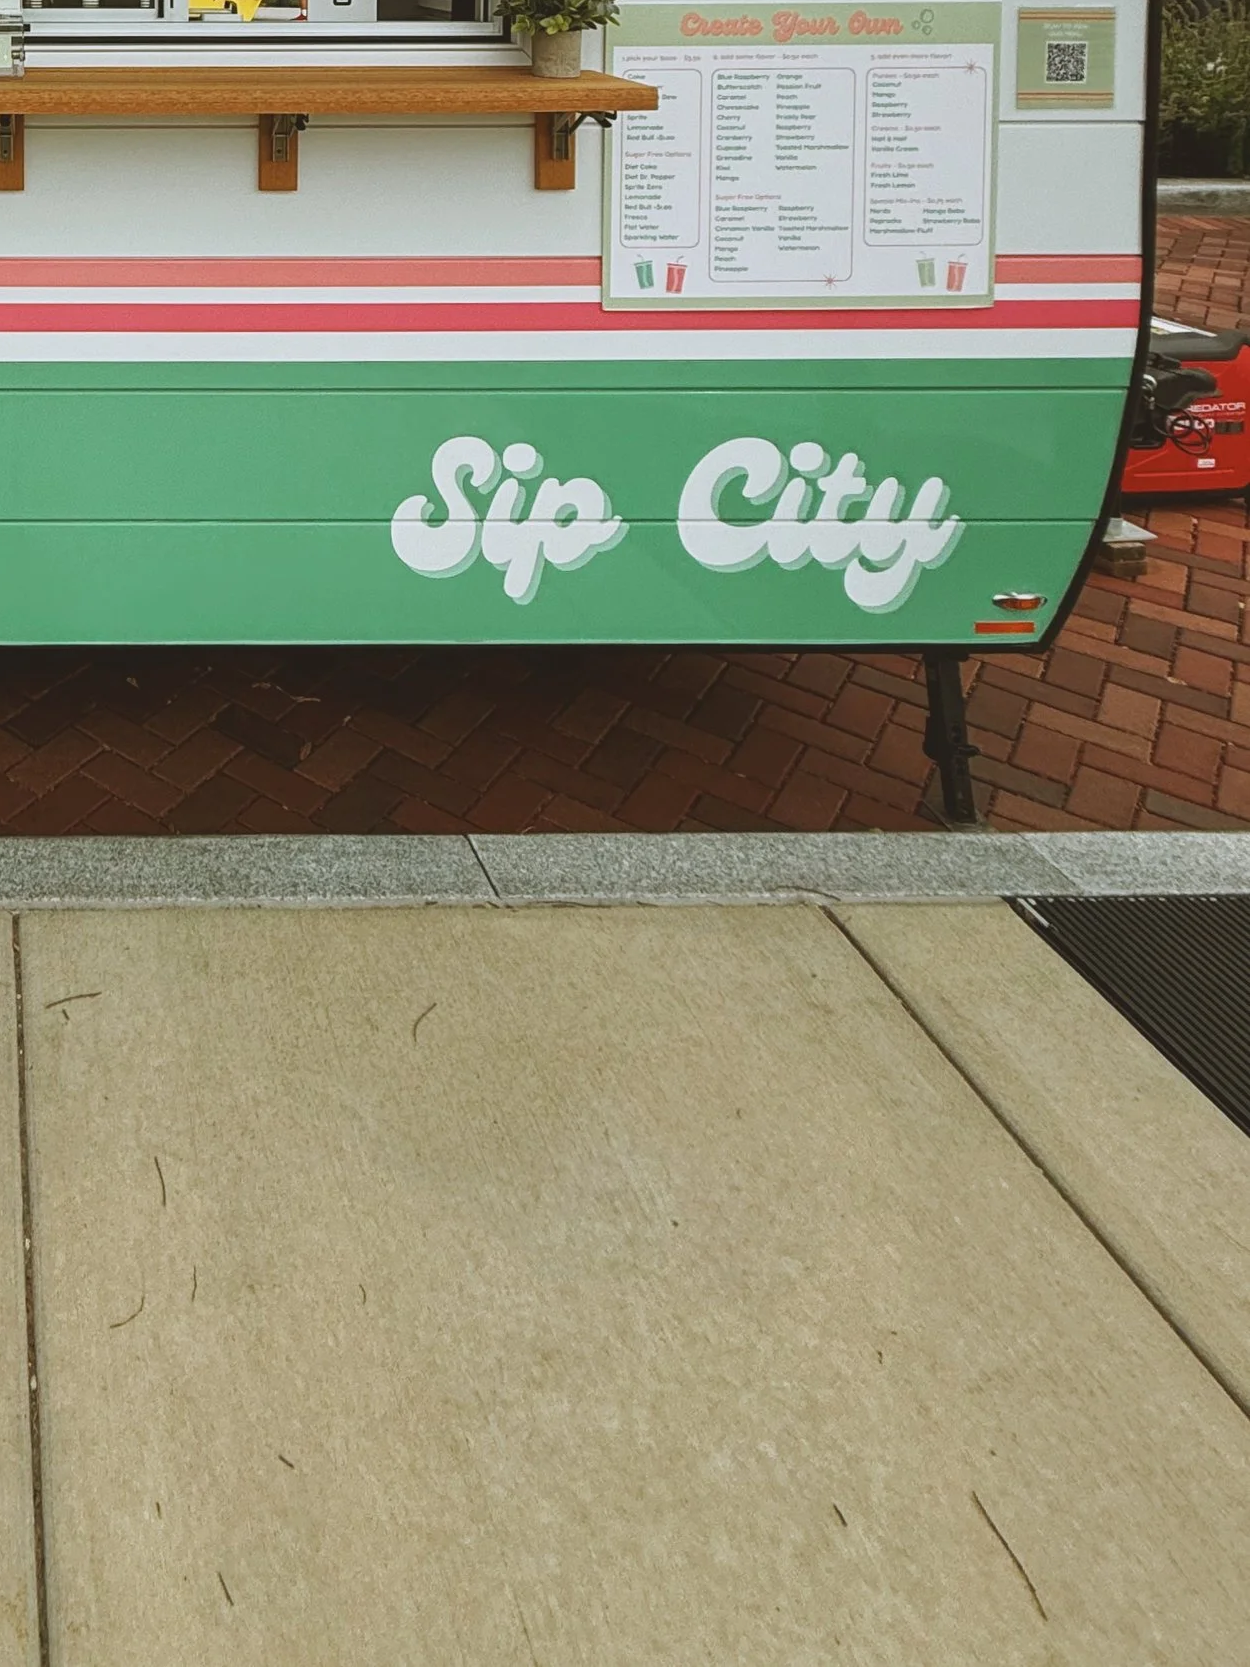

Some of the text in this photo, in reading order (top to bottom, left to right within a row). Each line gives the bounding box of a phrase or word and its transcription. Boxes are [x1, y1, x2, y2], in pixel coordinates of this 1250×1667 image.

[679, 9, 904, 44] Create Your Own
[734, 74, 770, 82] Raspberry
[1185, 402, 1246, 412] EDATOR
[390, 436, 966, 614] Sip City
